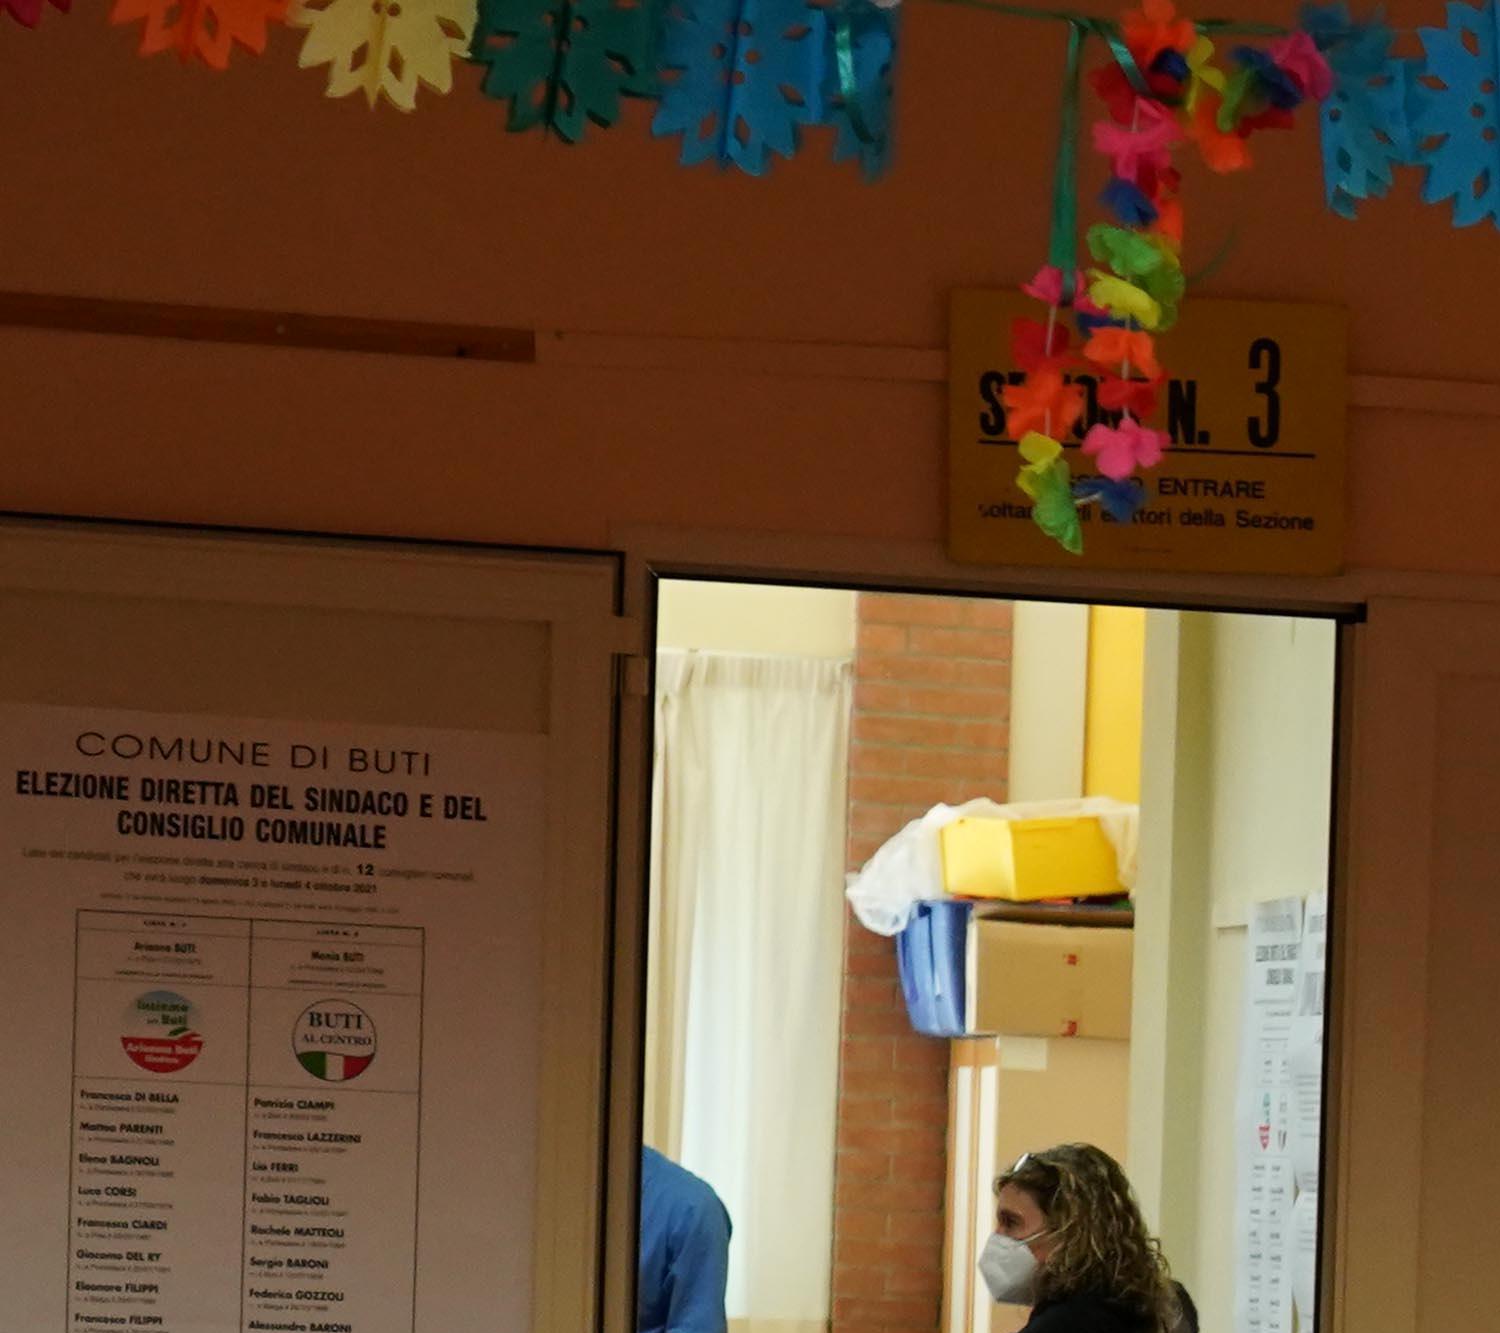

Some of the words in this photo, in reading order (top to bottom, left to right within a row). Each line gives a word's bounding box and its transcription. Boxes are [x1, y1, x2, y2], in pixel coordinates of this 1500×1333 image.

[1169, 379, 1209, 445] N.
[1247, 337, 1281, 447] 3
[1158, 477, 1265, 500] ENTRARE
[1179, 509, 1225, 528] della
[1236, 510, 1314, 530] Sezione
[75, 731, 271, 767] COMUNE
[290, 744, 328, 770] DI
[348, 748, 431, 776] BUTI
[16, 770, 129, 801] ELEZIONE
[140, 777, 239, 807] DIRETTA
[250, 784, 294, 810] DEL
[304, 787, 409, 818] SINDACO
[419, 794, 433, 818] E
[444, 796, 488, 821] DEL
[117, 809, 245, 842] CONSIGLIO
[255, 818, 388, 850] COMUNALE
[356, 864, 375, 876] 12
[308, 1011, 363, 1029] BUTI
[320, 1035, 372, 1046] CENTRO
[119, 1123, 163, 1134] PARENTI
